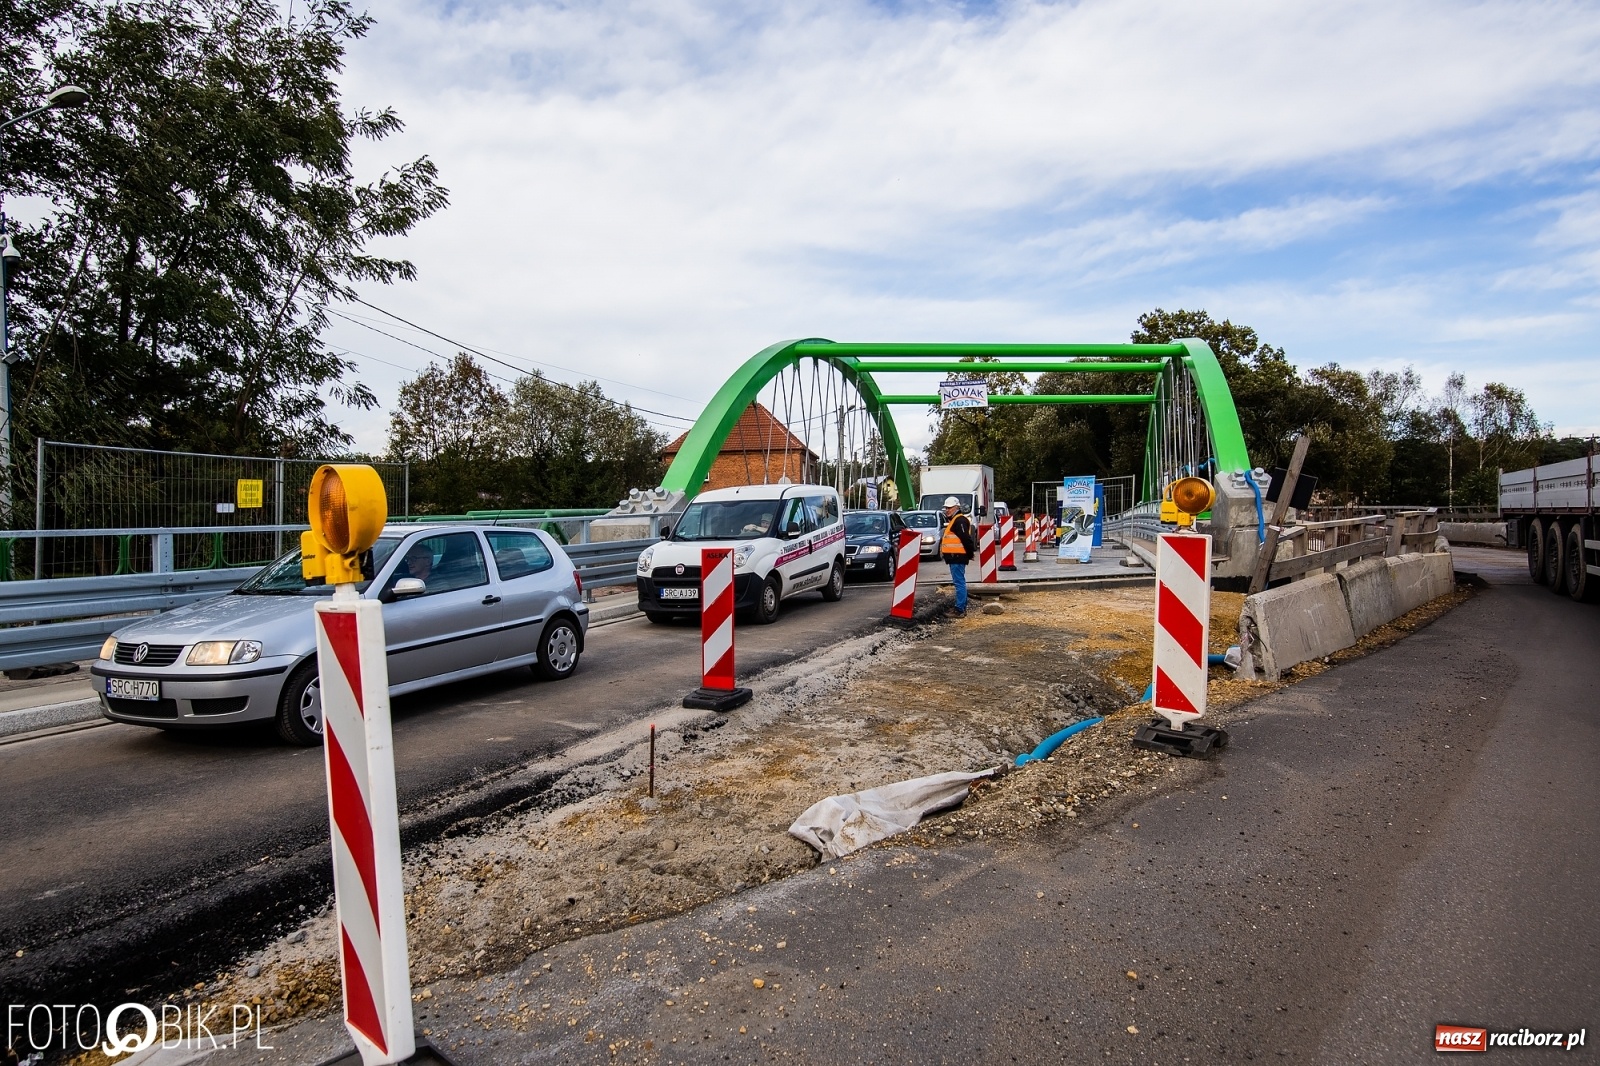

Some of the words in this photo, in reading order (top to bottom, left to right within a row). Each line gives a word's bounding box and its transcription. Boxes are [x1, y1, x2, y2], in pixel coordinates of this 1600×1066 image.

[943, 387, 984, 401] NOWAK
[947, 399, 981, 407] MOSTY
[1067, 479, 1091, 489] NOWAK
